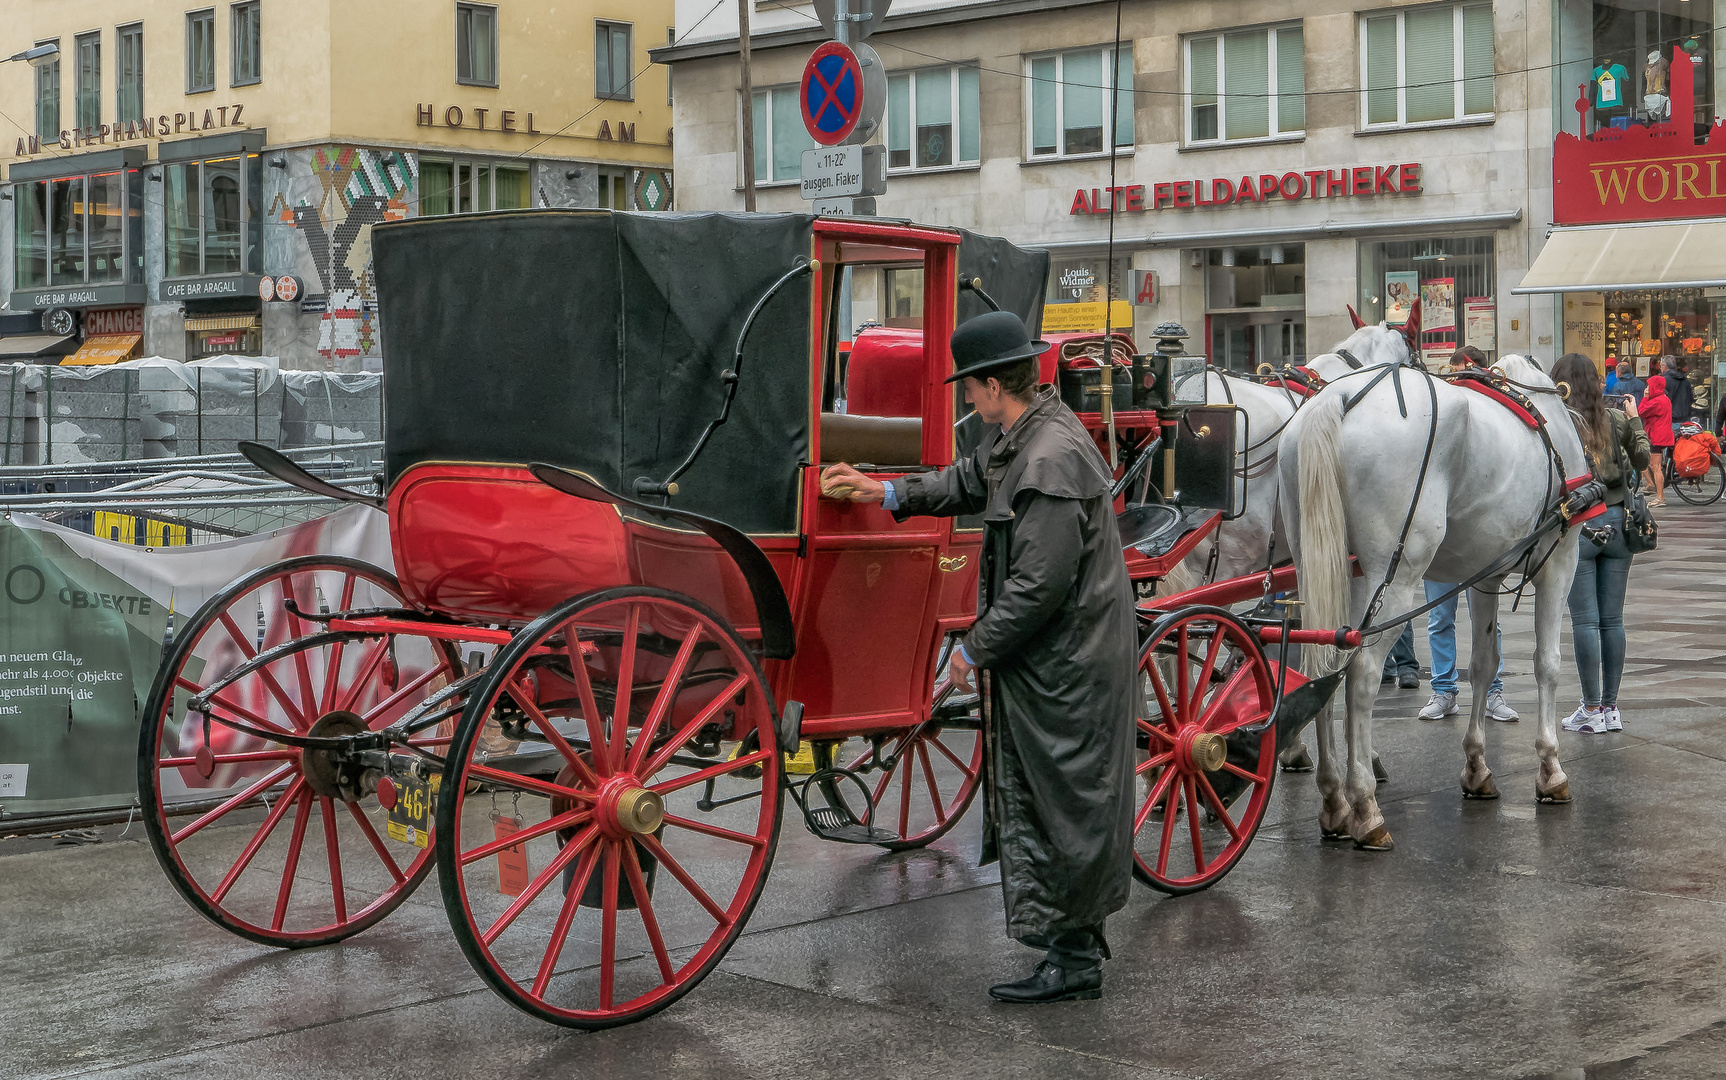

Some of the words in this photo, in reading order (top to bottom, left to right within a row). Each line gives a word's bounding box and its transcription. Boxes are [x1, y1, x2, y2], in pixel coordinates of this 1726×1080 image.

[15, 134, 42, 157] AM
[59, 104, 244, 150] STEPHANSPLATZ
[416, 103, 540, 134] HOTEL
[597, 119, 636, 142] AM
[803, 177, 833, 192] ausgen.
[836, 172, 860, 187] Fiaker
[1069, 184, 1144, 215] ALTE
[1153, 162, 1421, 210] FELDAPOTHEKE
[1064, 267, 1089, 277] Louis
[167, 284, 185, 296] CAFE
[187, 283, 201, 294] BAR
[203, 281, 237, 293] ARAGALL
[1059, 276, 1095, 286] Widmer
[35, 294, 51, 306] CAFE
[52, 293, 65, 304] BAR
[68, 291, 97, 303] ARAGALL
[87, 309, 141, 334] CHANGE
[1566, 321, 1604, 331] SIGHTSEEING
[1578, 330, 1602, 341] TICKETS
[59, 586, 151, 616] OBJEKTE
[10, 652, 48, 662] neuem
[23, 667, 39, 679] als
[77, 670, 123, 685] Objekte
[51, 683, 75, 700] und
[77, 688, 94, 700] die
